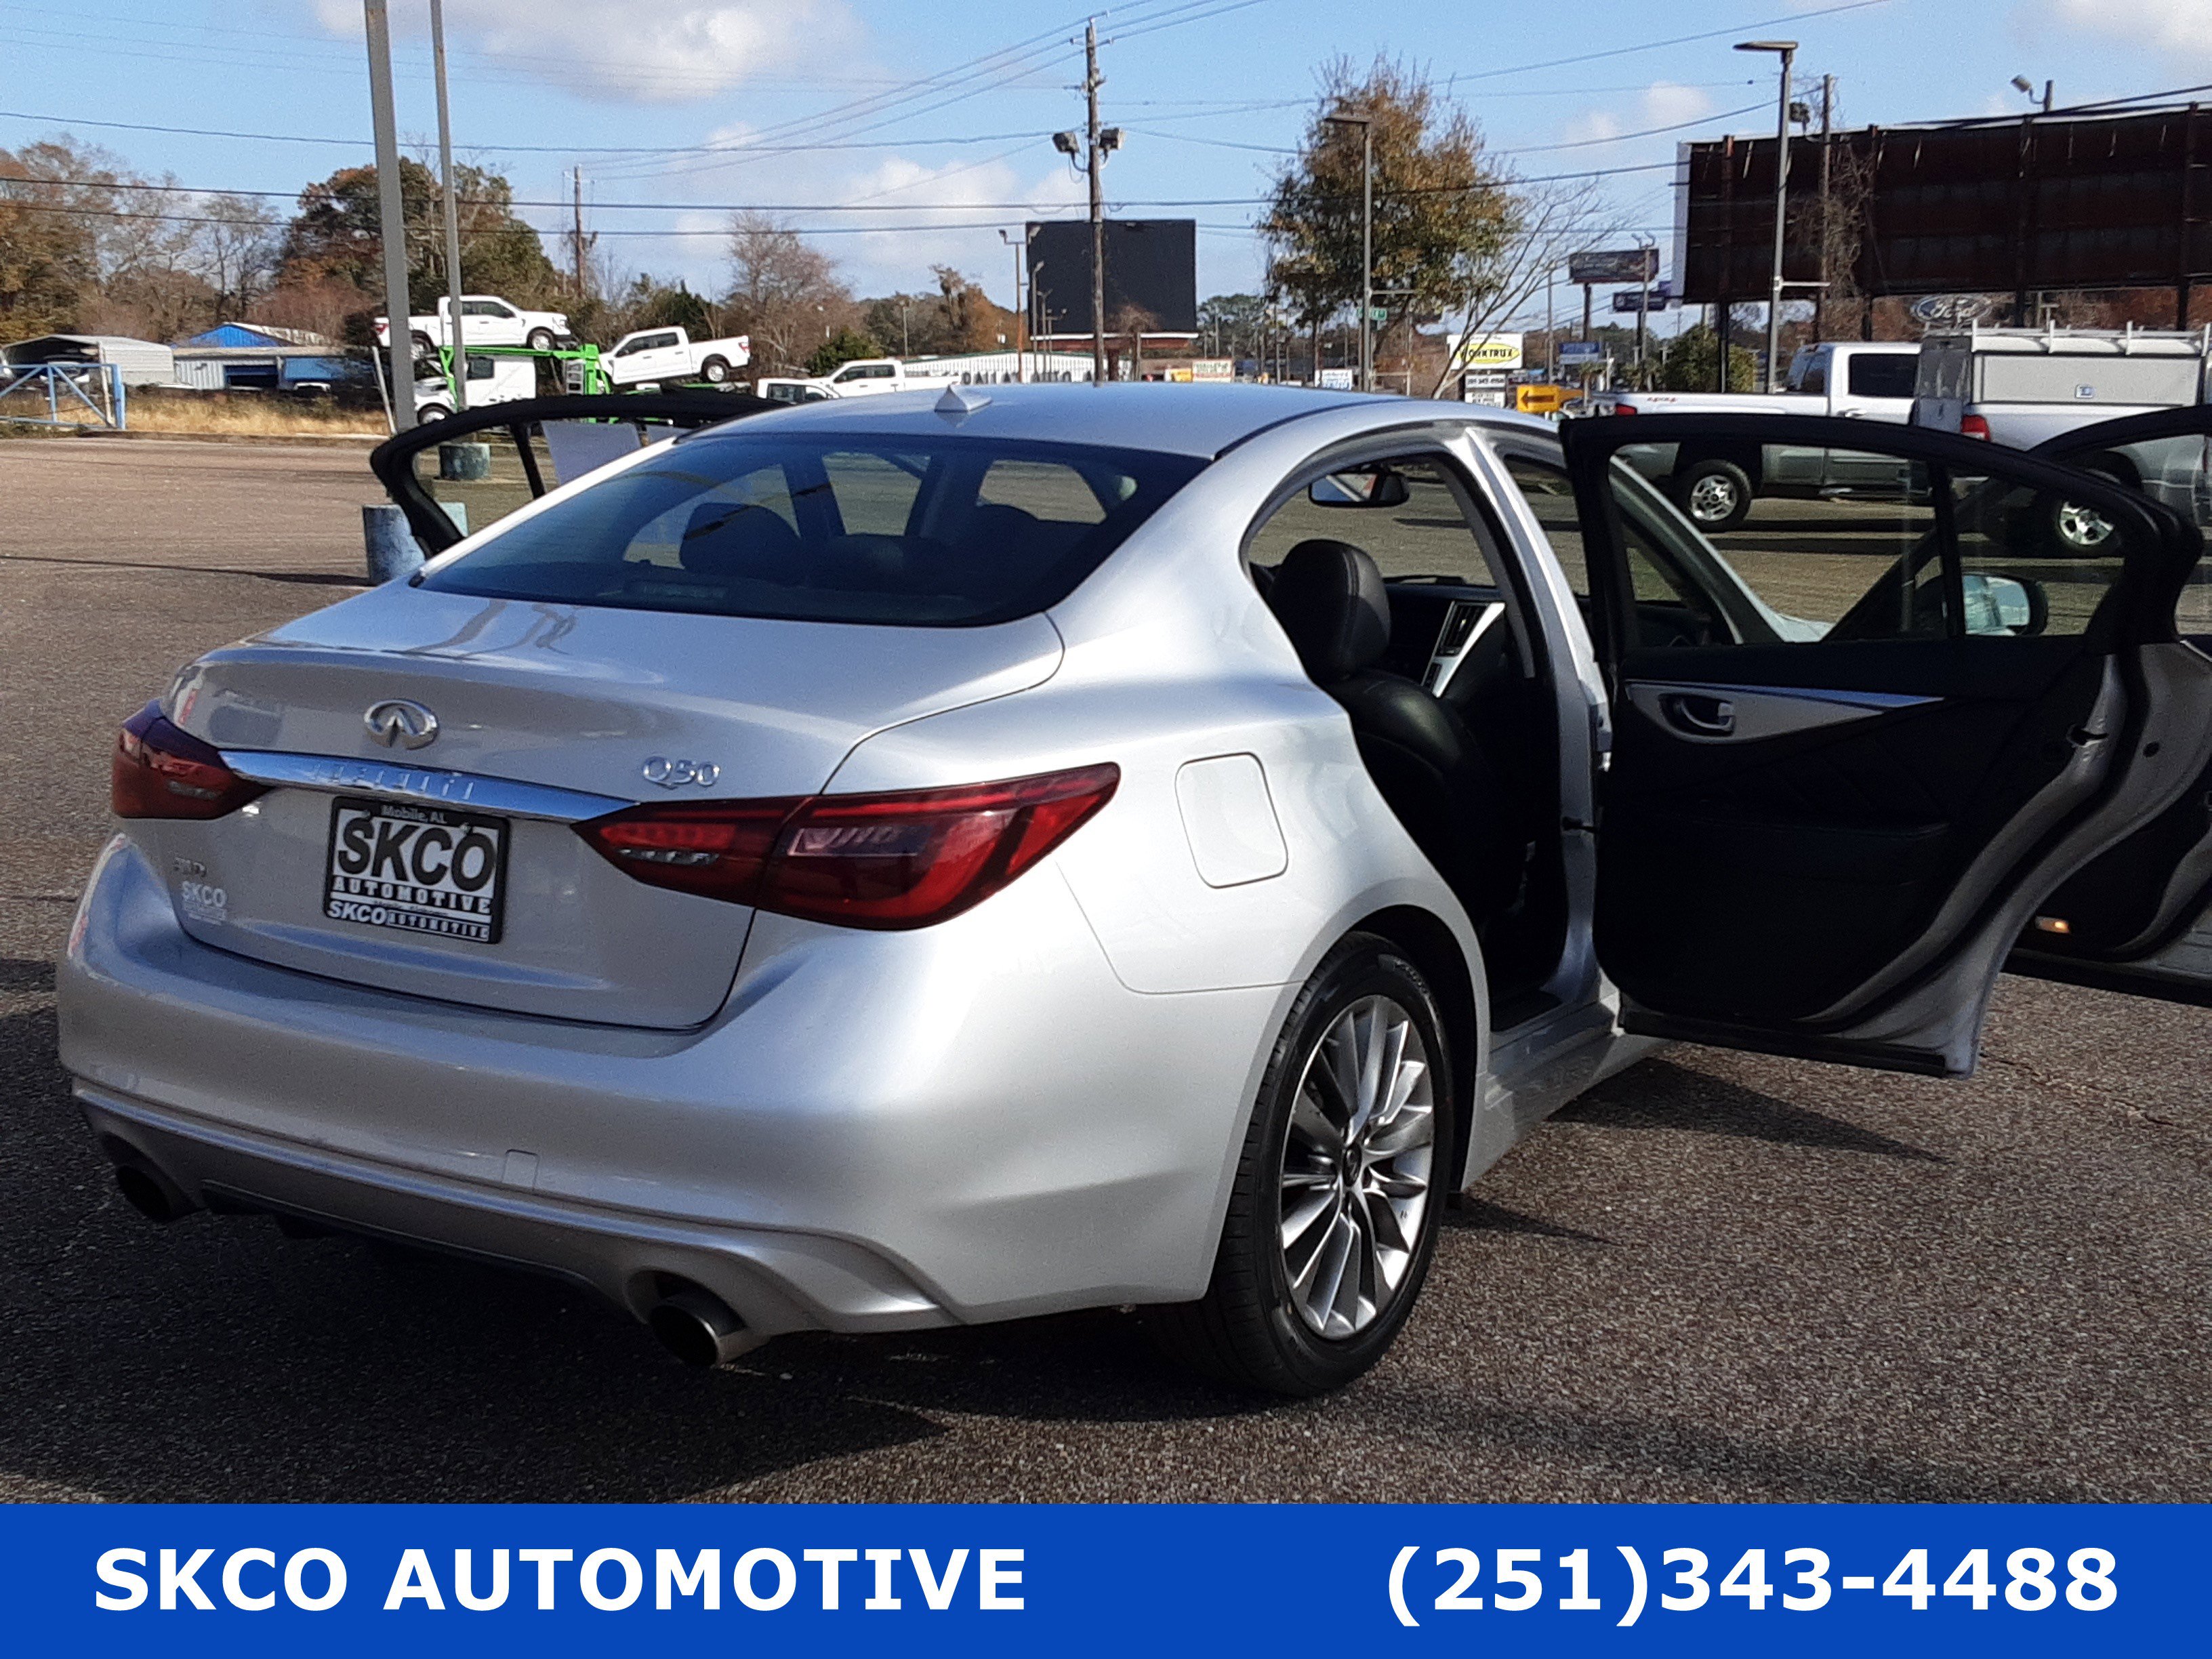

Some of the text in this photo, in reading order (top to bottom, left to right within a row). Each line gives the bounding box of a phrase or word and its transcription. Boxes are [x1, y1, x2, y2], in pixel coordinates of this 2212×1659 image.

[641, 755, 720, 790] Q50
[337, 817, 497, 893] SKCO
[327, 899, 388, 926] SKCO
[332, 876, 492, 914] AUTOMOTIVE
[388, 912, 489, 939] AUTOMOTIVE
